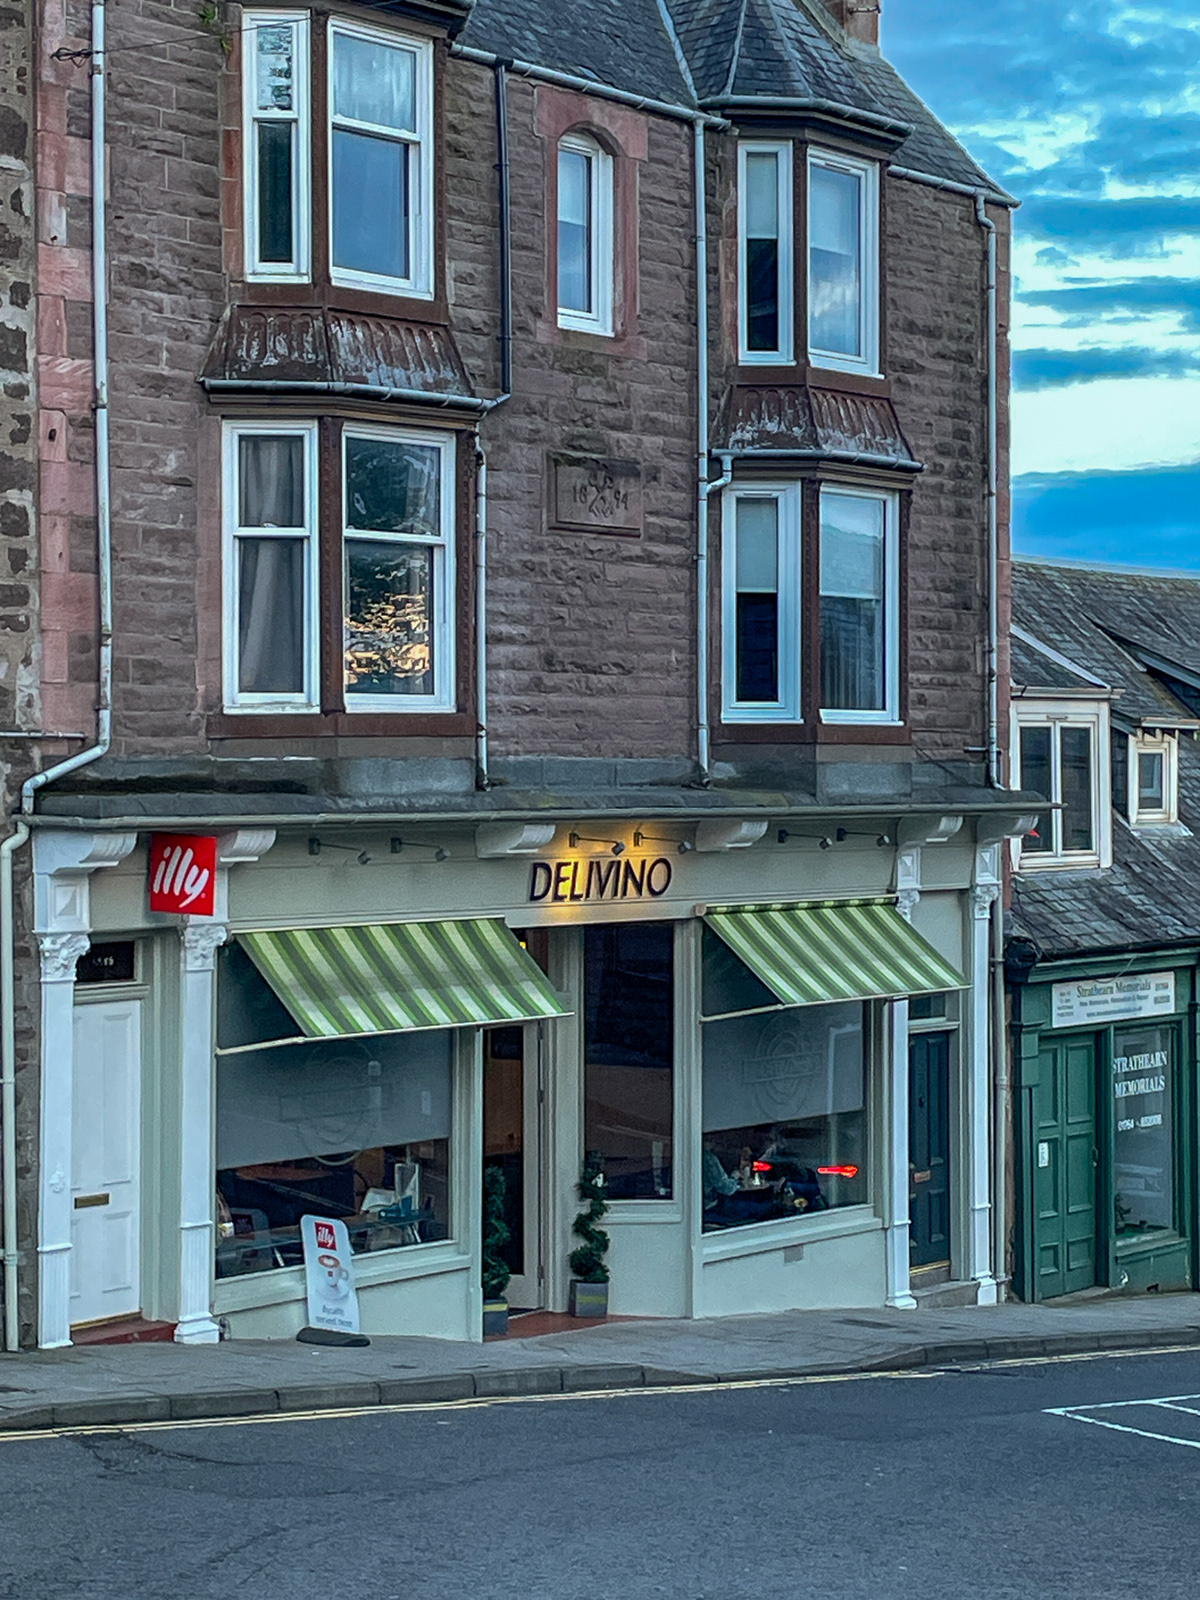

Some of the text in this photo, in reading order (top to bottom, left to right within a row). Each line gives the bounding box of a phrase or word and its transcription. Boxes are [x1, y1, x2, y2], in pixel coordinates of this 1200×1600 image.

[153, 846, 210, 908] illy
[530, 857, 673, 902] DELIVINO
[1112, 1051, 1168, 1074] STRATHEARN
[1115, 1075, 1166, 1098] MEMORIALS
[317, 1226, 335, 1248] illy
